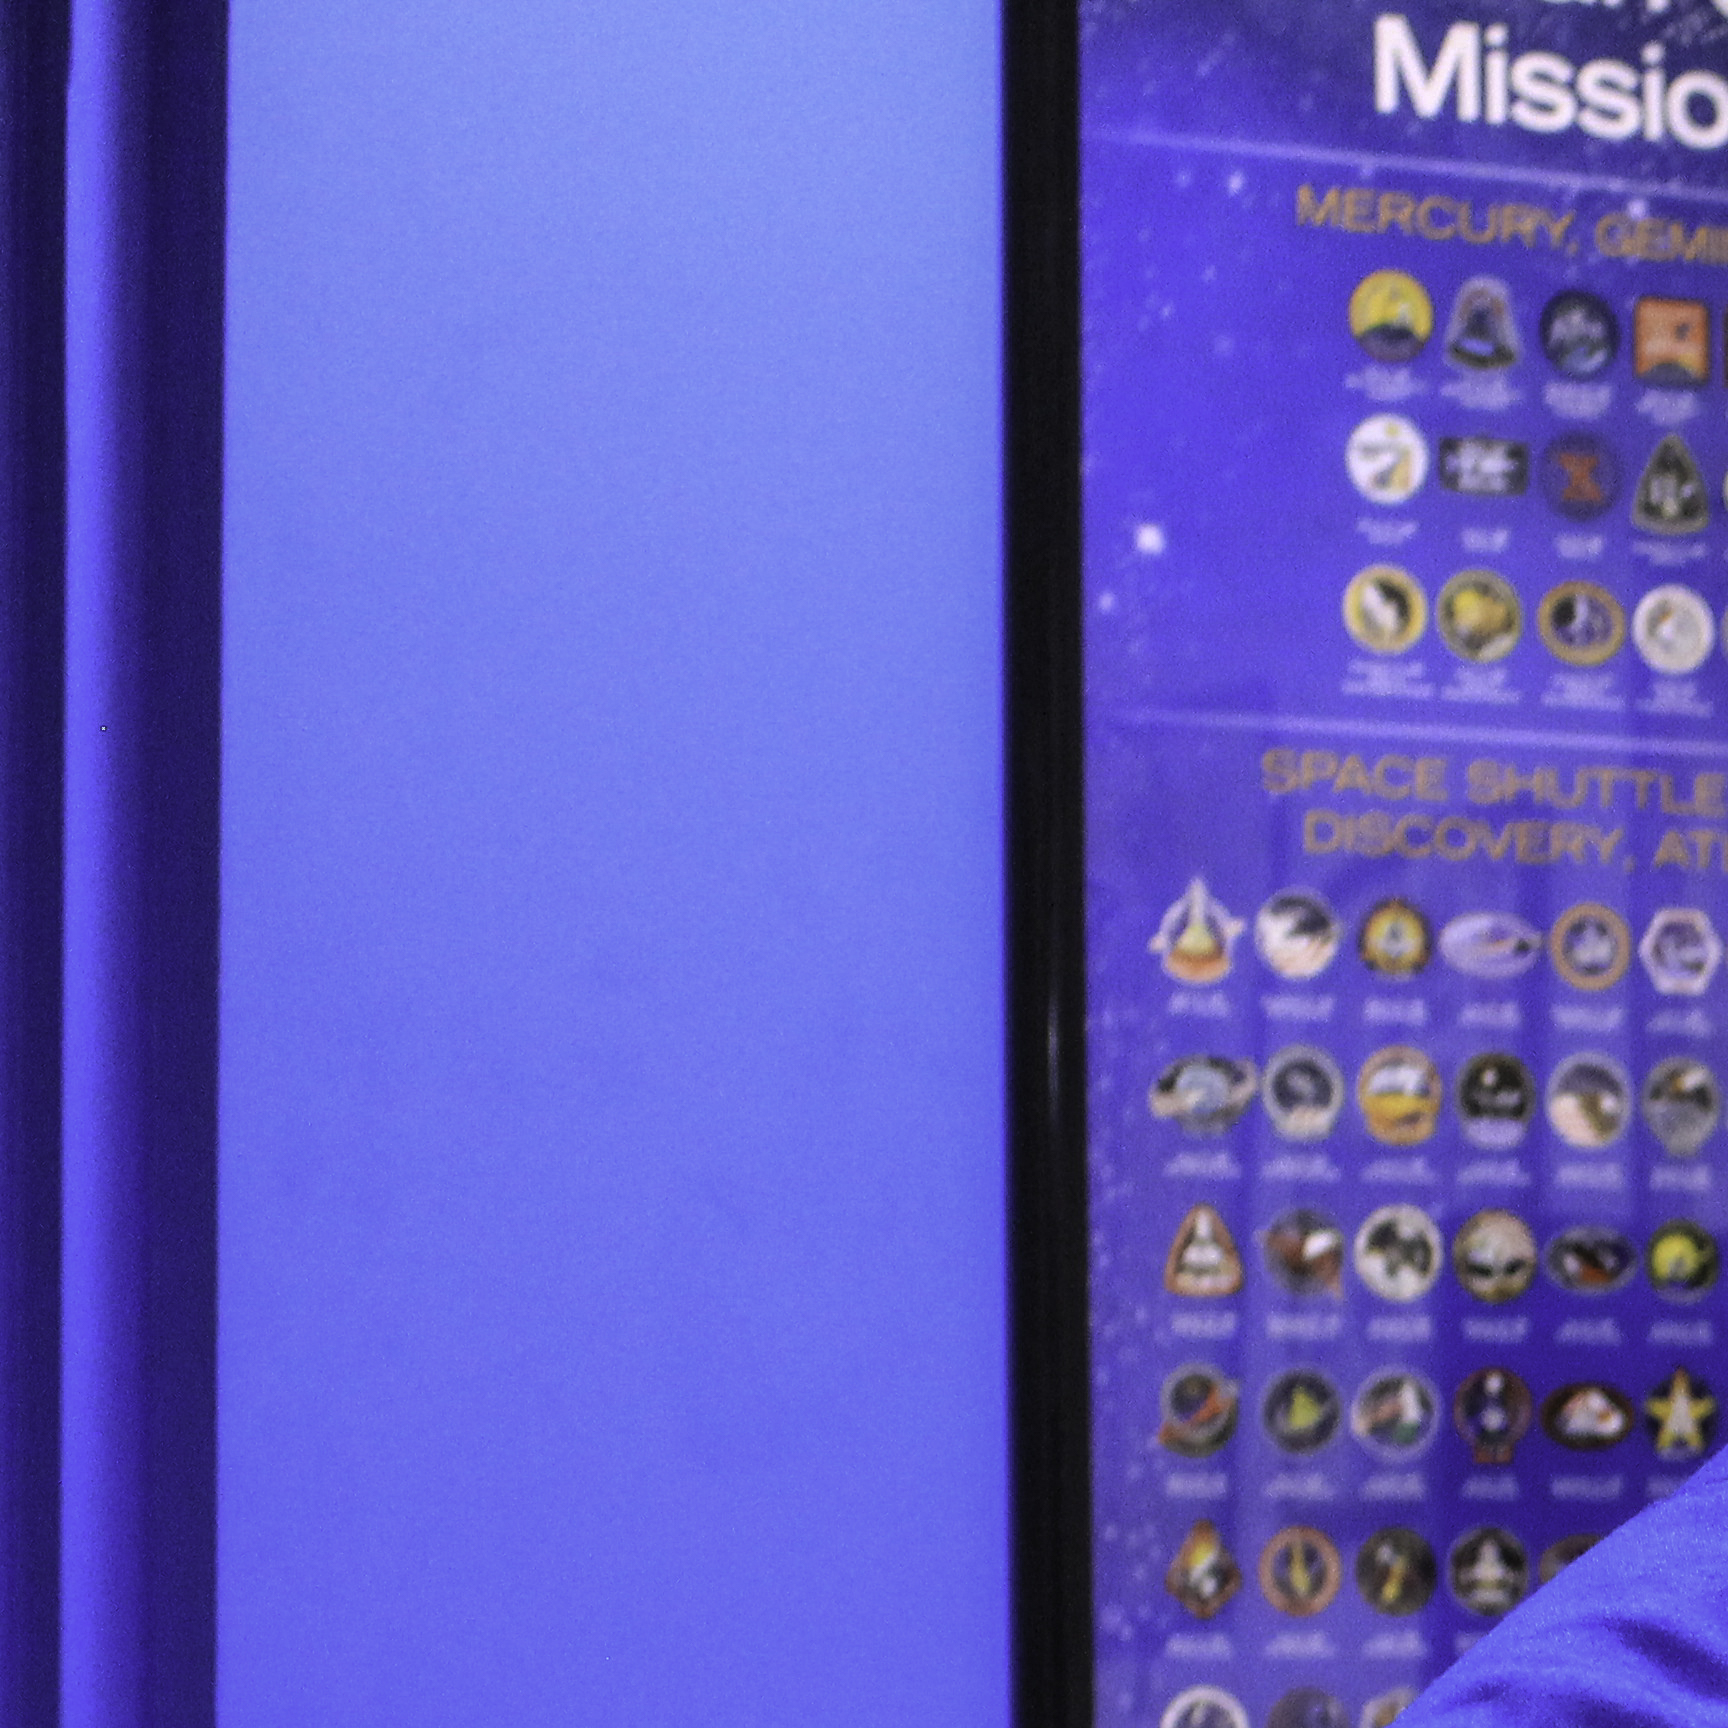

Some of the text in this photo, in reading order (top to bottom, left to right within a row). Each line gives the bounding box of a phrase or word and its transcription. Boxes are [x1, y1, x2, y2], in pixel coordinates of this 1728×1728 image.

[1295, 184, 1578, 255] MERCURY,
[1261, 747, 1449, 803] SPACE
[1465, 758, 1727, 819] SHUTTLE
[1302, 807, 1635, 873] DISCOVERY,
